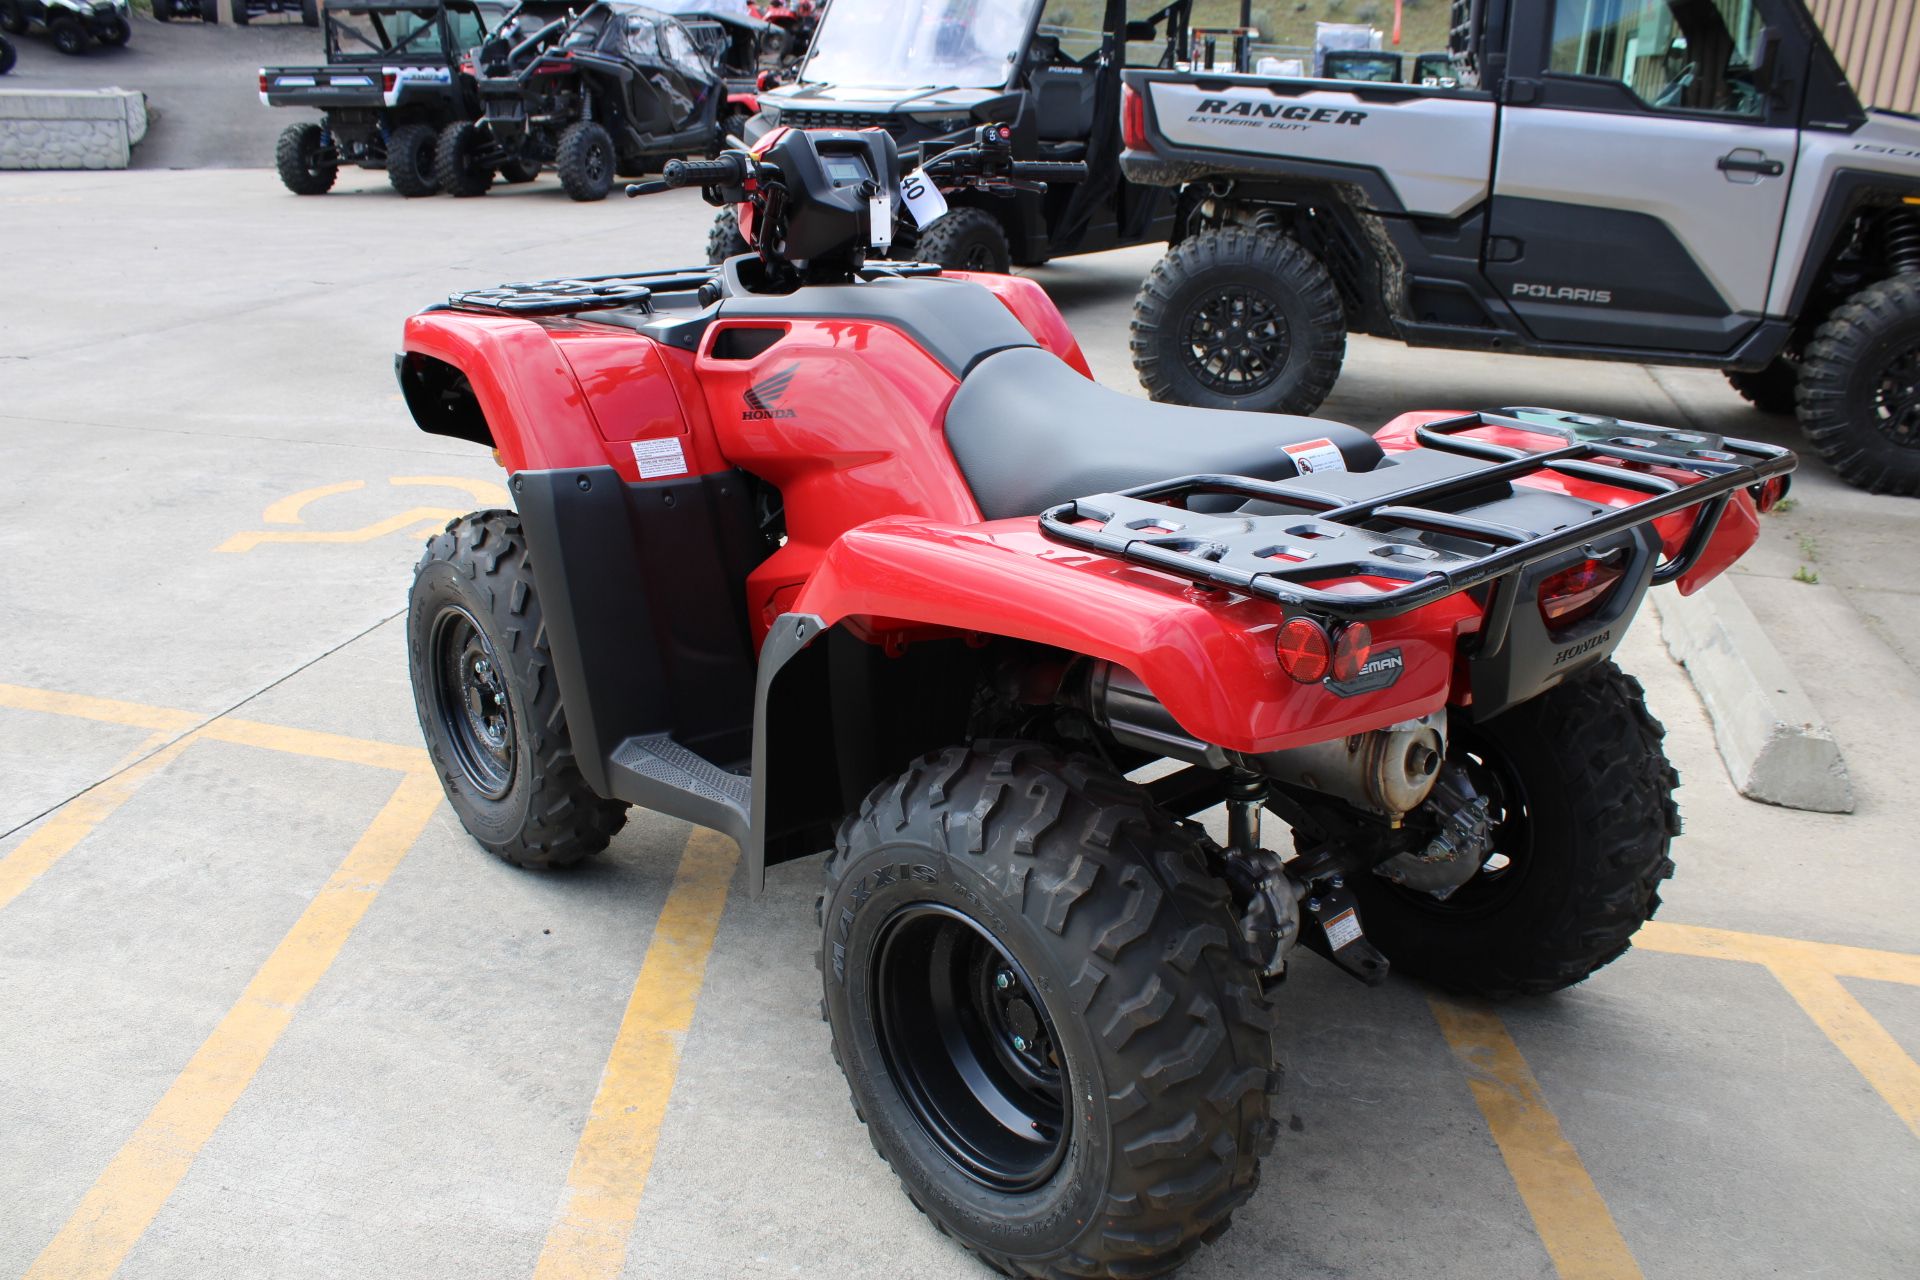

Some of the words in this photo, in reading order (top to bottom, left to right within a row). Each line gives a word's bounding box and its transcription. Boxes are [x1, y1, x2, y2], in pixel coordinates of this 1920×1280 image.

[1187, 115, 1264, 127] EXTREME
[1268, 122, 1311, 131] DUTY
[1196, 98, 1368, 125] RANGER
[1512, 283, 1611, 303] POLARIS
[742, 409, 798, 420] HONDA
[1552, 629, 1611, 666] HONDA
[832, 863, 938, 985] MAXXIS
